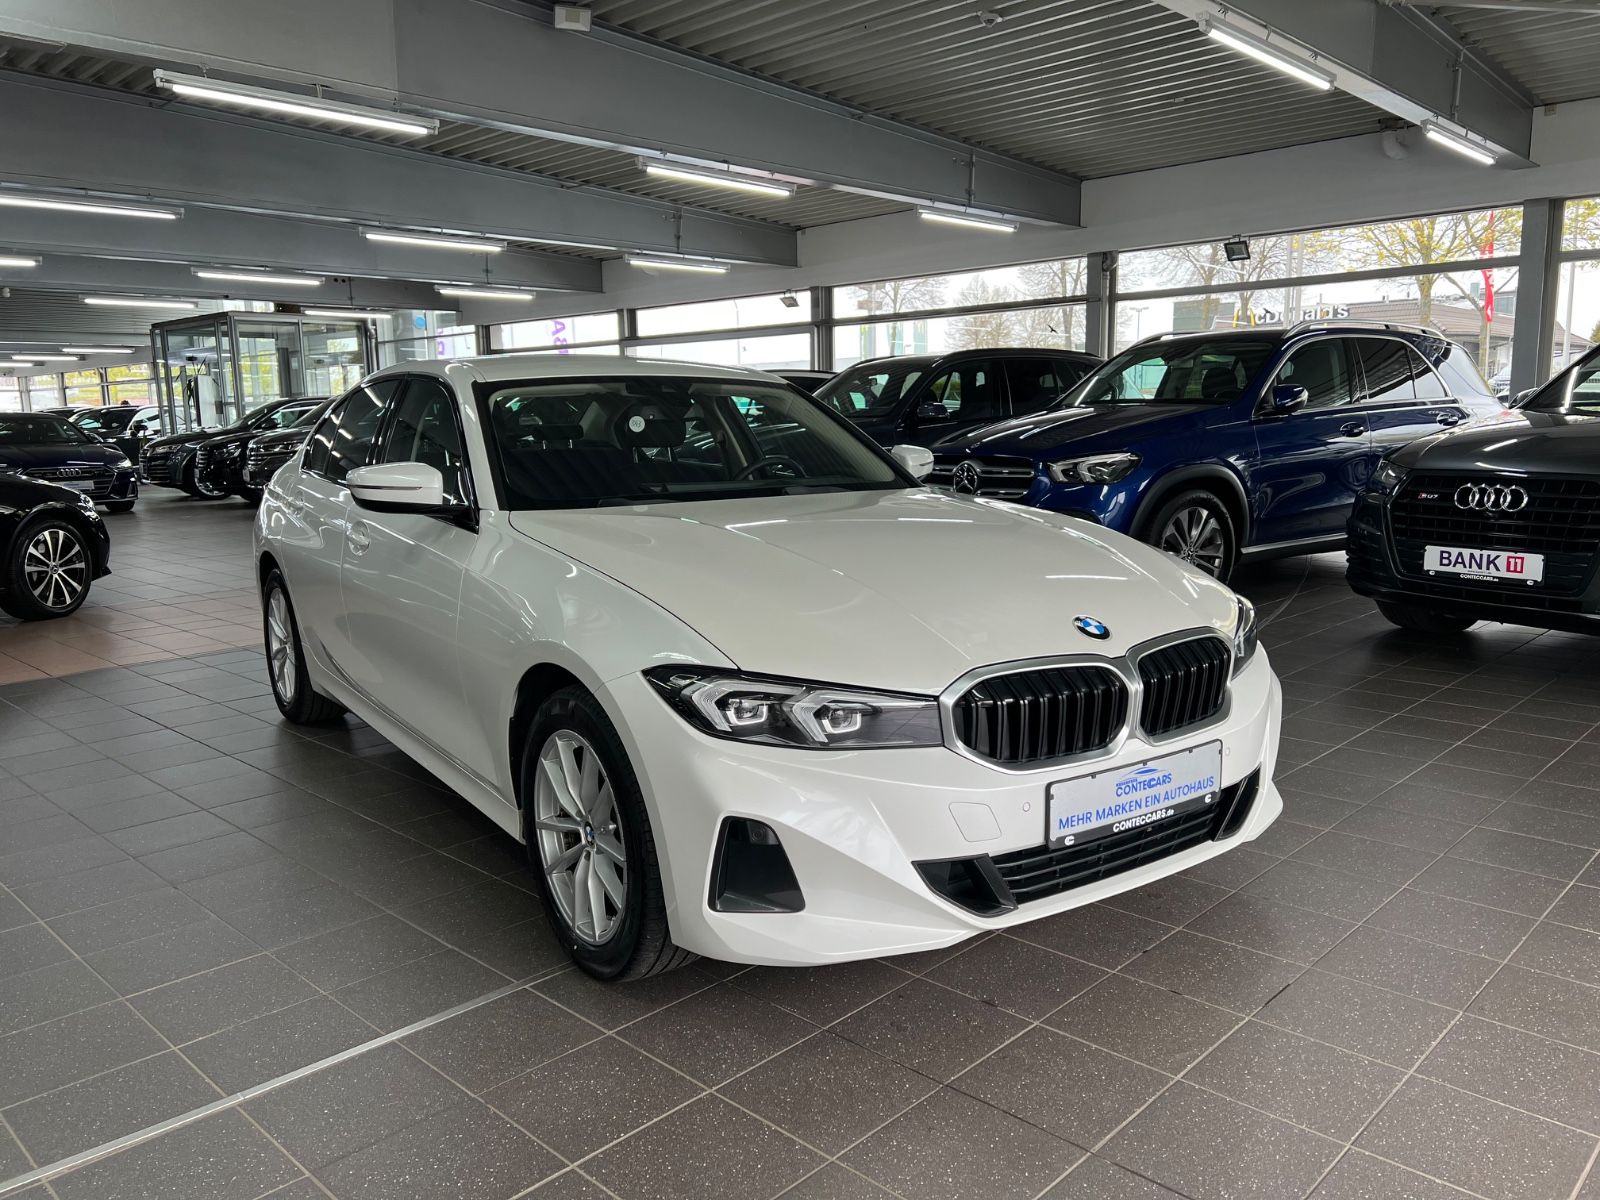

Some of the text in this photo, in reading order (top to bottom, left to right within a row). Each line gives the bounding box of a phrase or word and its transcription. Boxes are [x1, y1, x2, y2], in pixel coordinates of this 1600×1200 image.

[1439, 550, 1523, 572] BANK 11
[1058, 811, 1092, 830] MEHR
[1096, 798, 1142, 822] MARKEN
[1145, 794, 1161, 808] EIN
[1163, 776, 1214, 804] AUTOHAUS
[1112, 808, 1174, 832] CONTECCARS.de
